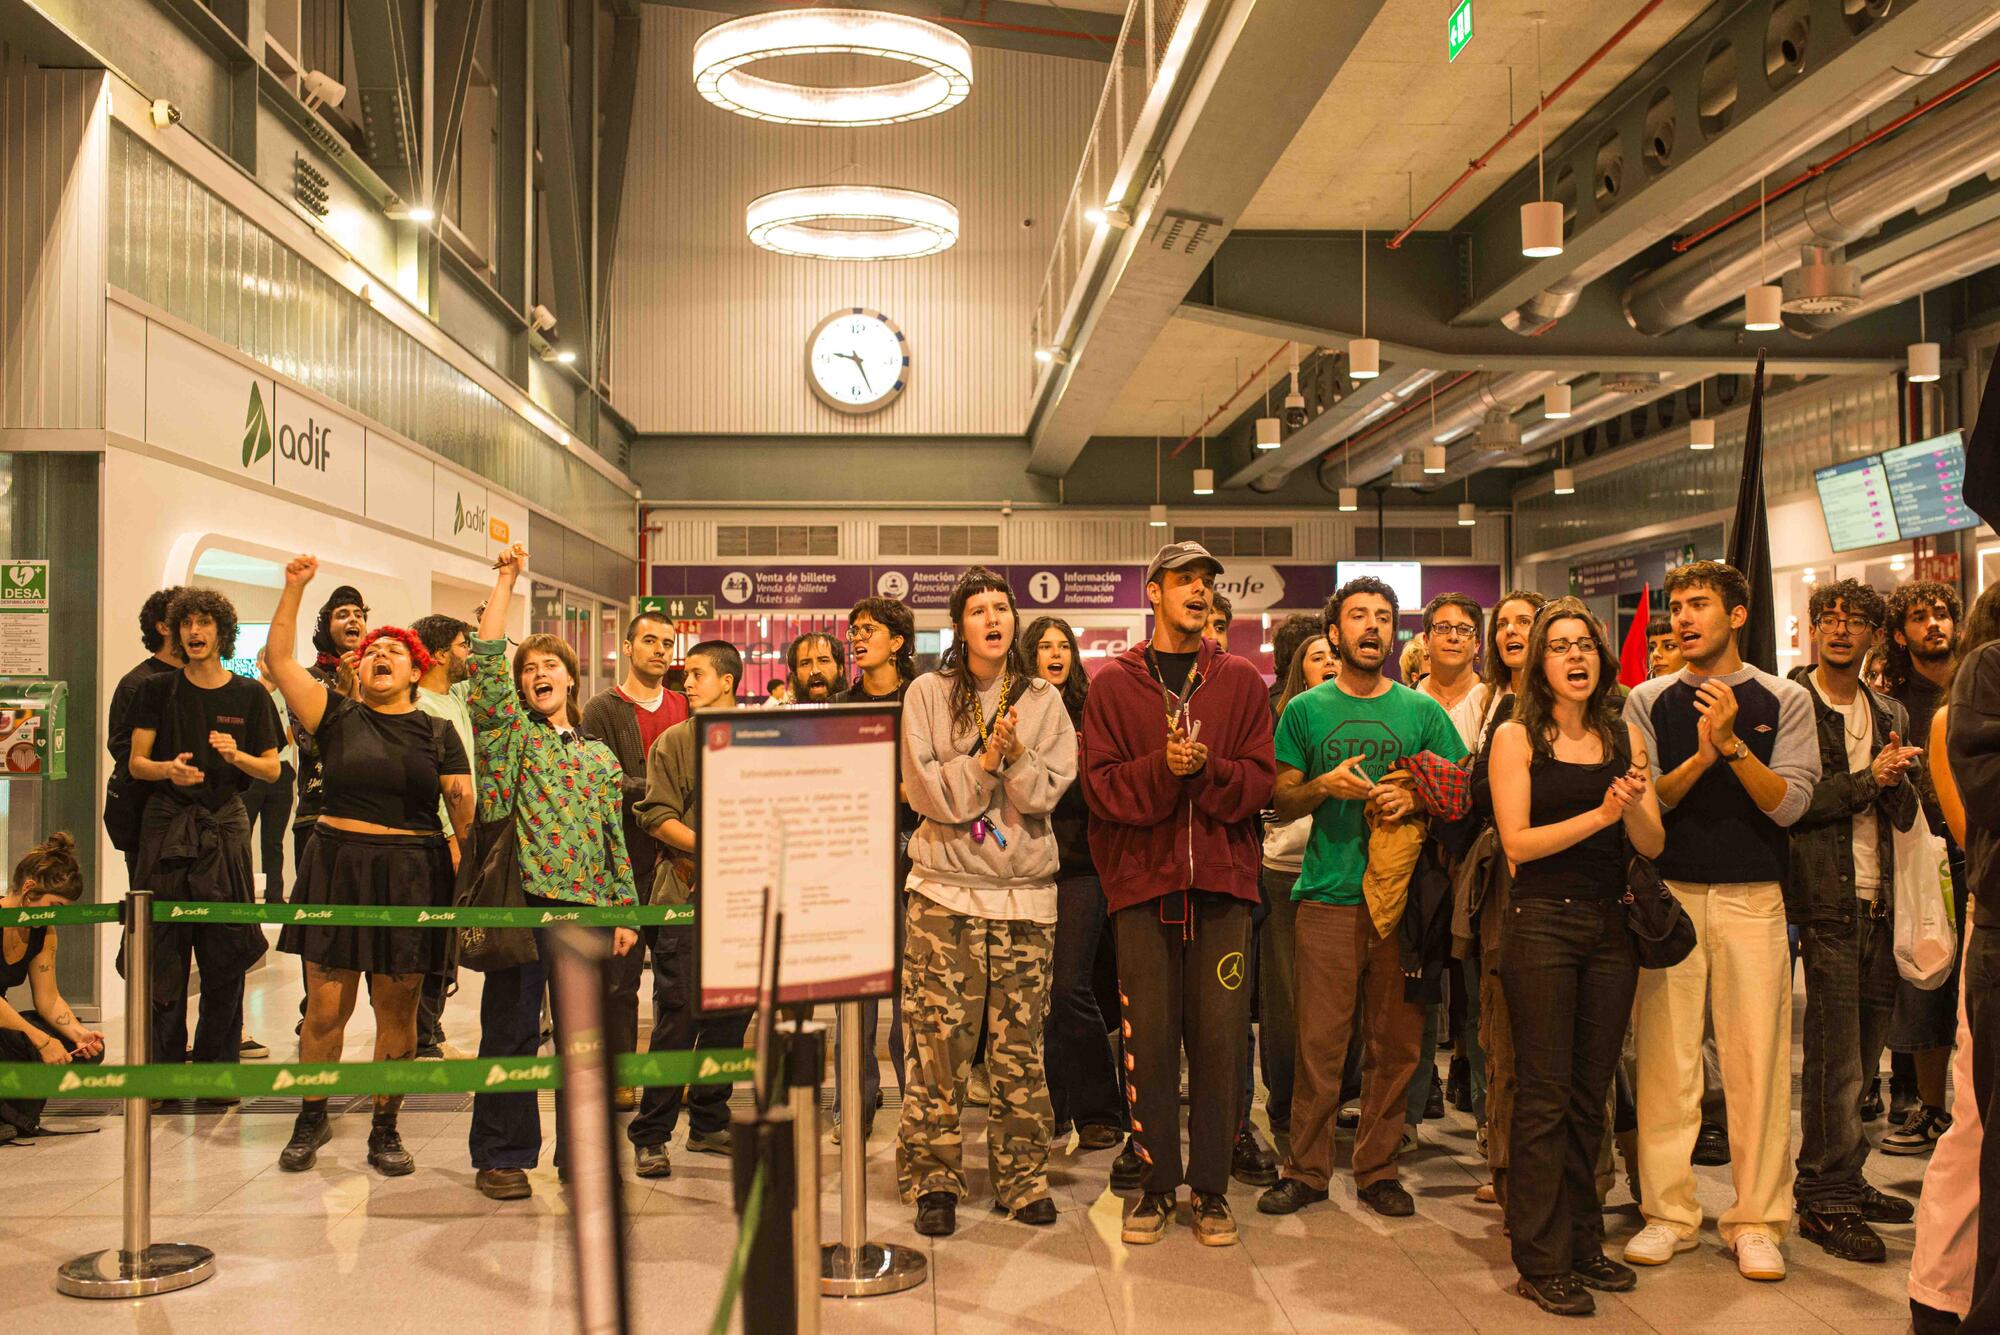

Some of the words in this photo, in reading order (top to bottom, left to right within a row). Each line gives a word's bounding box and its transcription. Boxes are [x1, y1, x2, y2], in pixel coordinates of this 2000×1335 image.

[279, 418, 331, 472] adif
[466, 505, 486, 534] adif
[756, 572, 783, 582] Venta
[785, 572, 798, 582] de
[801, 572, 837, 582] billetes
[912, 571, 955, 582] Atención
[1064, 571, 1121, 582] Información
[757, 583, 783, 593] Venda
[784, 583, 796, 593] de
[798, 583, 828, 593] billetes
[912, 582, 950, 592] Atención
[1213, 575, 1264, 599] enfe
[5, 588, 42, 599] DESA
[756, 594, 783, 604] Tickets
[785, 594, 802, 604] sale
[1327, 739, 1396, 761] STOP
[31, 911, 57, 920] adif
[184, 907, 210, 916] adif
[308, 910, 334, 918] adif
[431, 912, 457, 920] adif
[554, 912, 580, 921] adif
[677, 909, 694, 918] ad
[508, 1064, 551, 1080] adif
[82, 1072, 127, 1088] adif
[296, 1070, 341, 1086] adif
